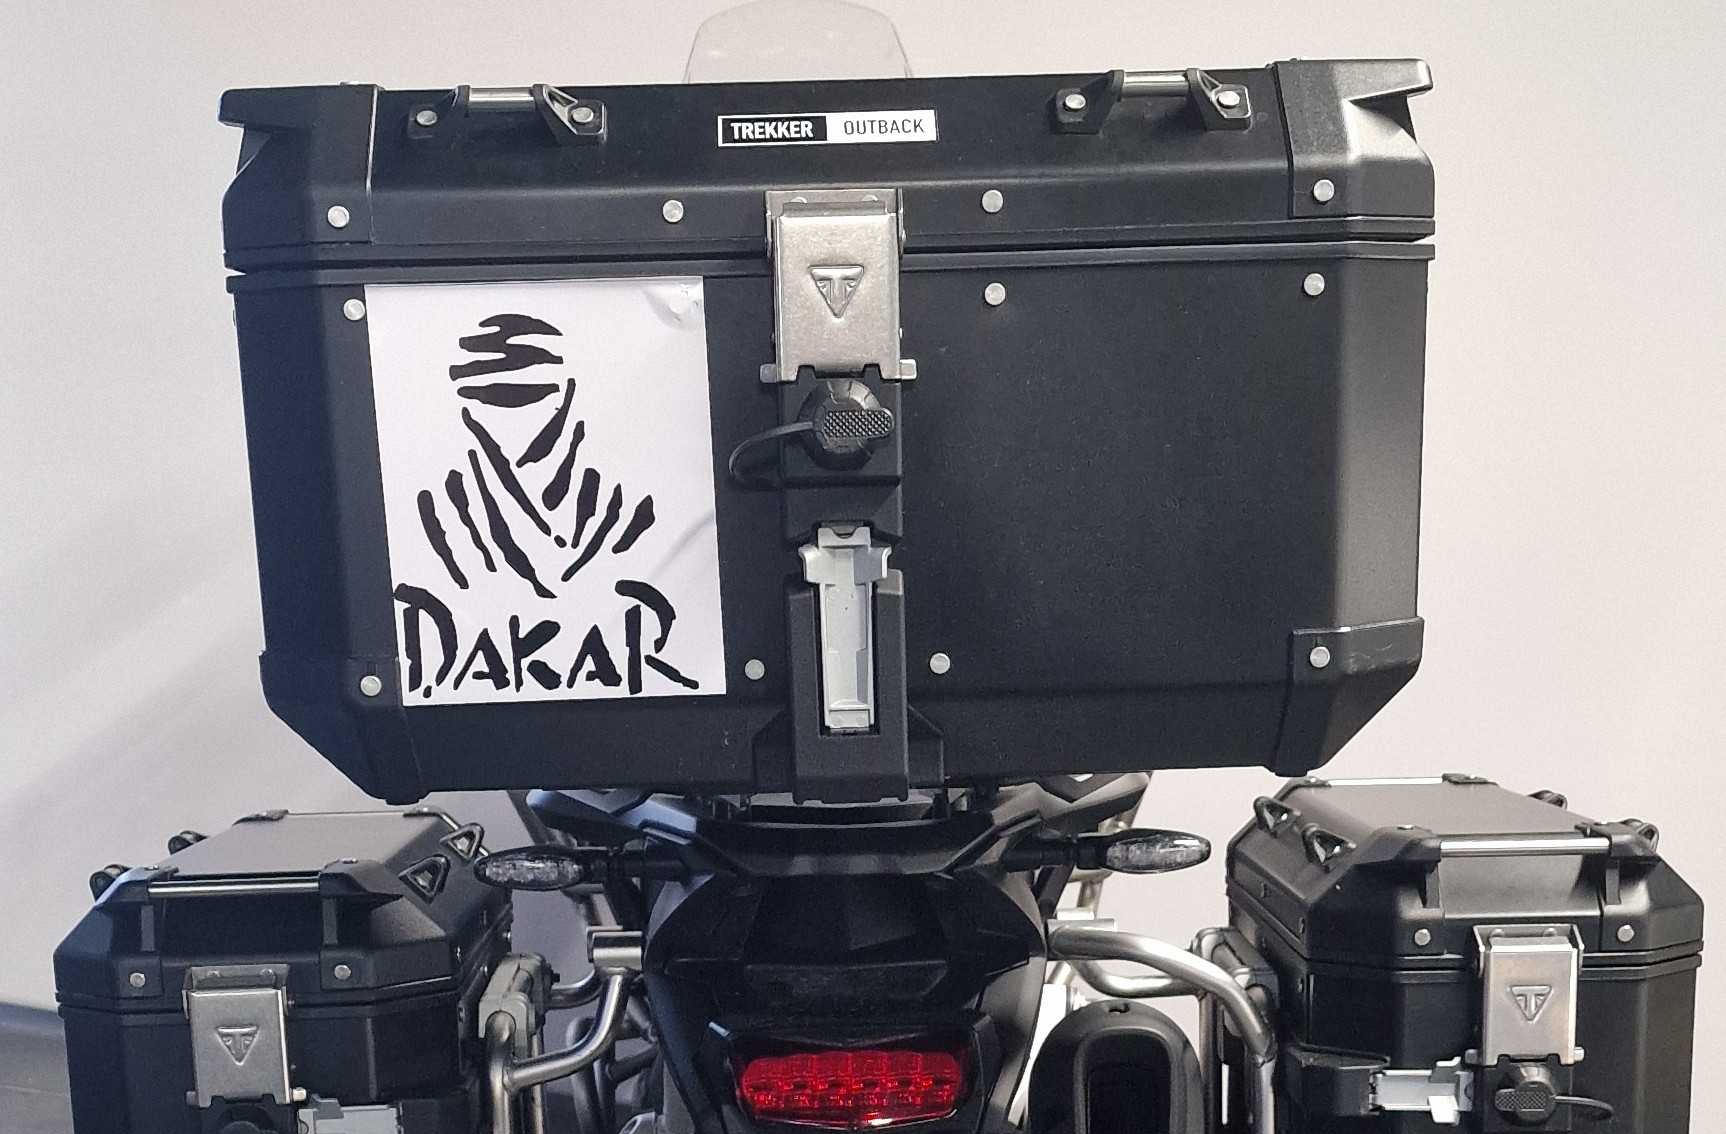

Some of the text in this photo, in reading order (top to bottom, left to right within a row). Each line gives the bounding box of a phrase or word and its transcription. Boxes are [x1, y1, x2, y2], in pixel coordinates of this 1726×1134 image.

[730, 119, 924, 140] TREKKER OUTBACK
[394, 579, 700, 699] DAKAR
